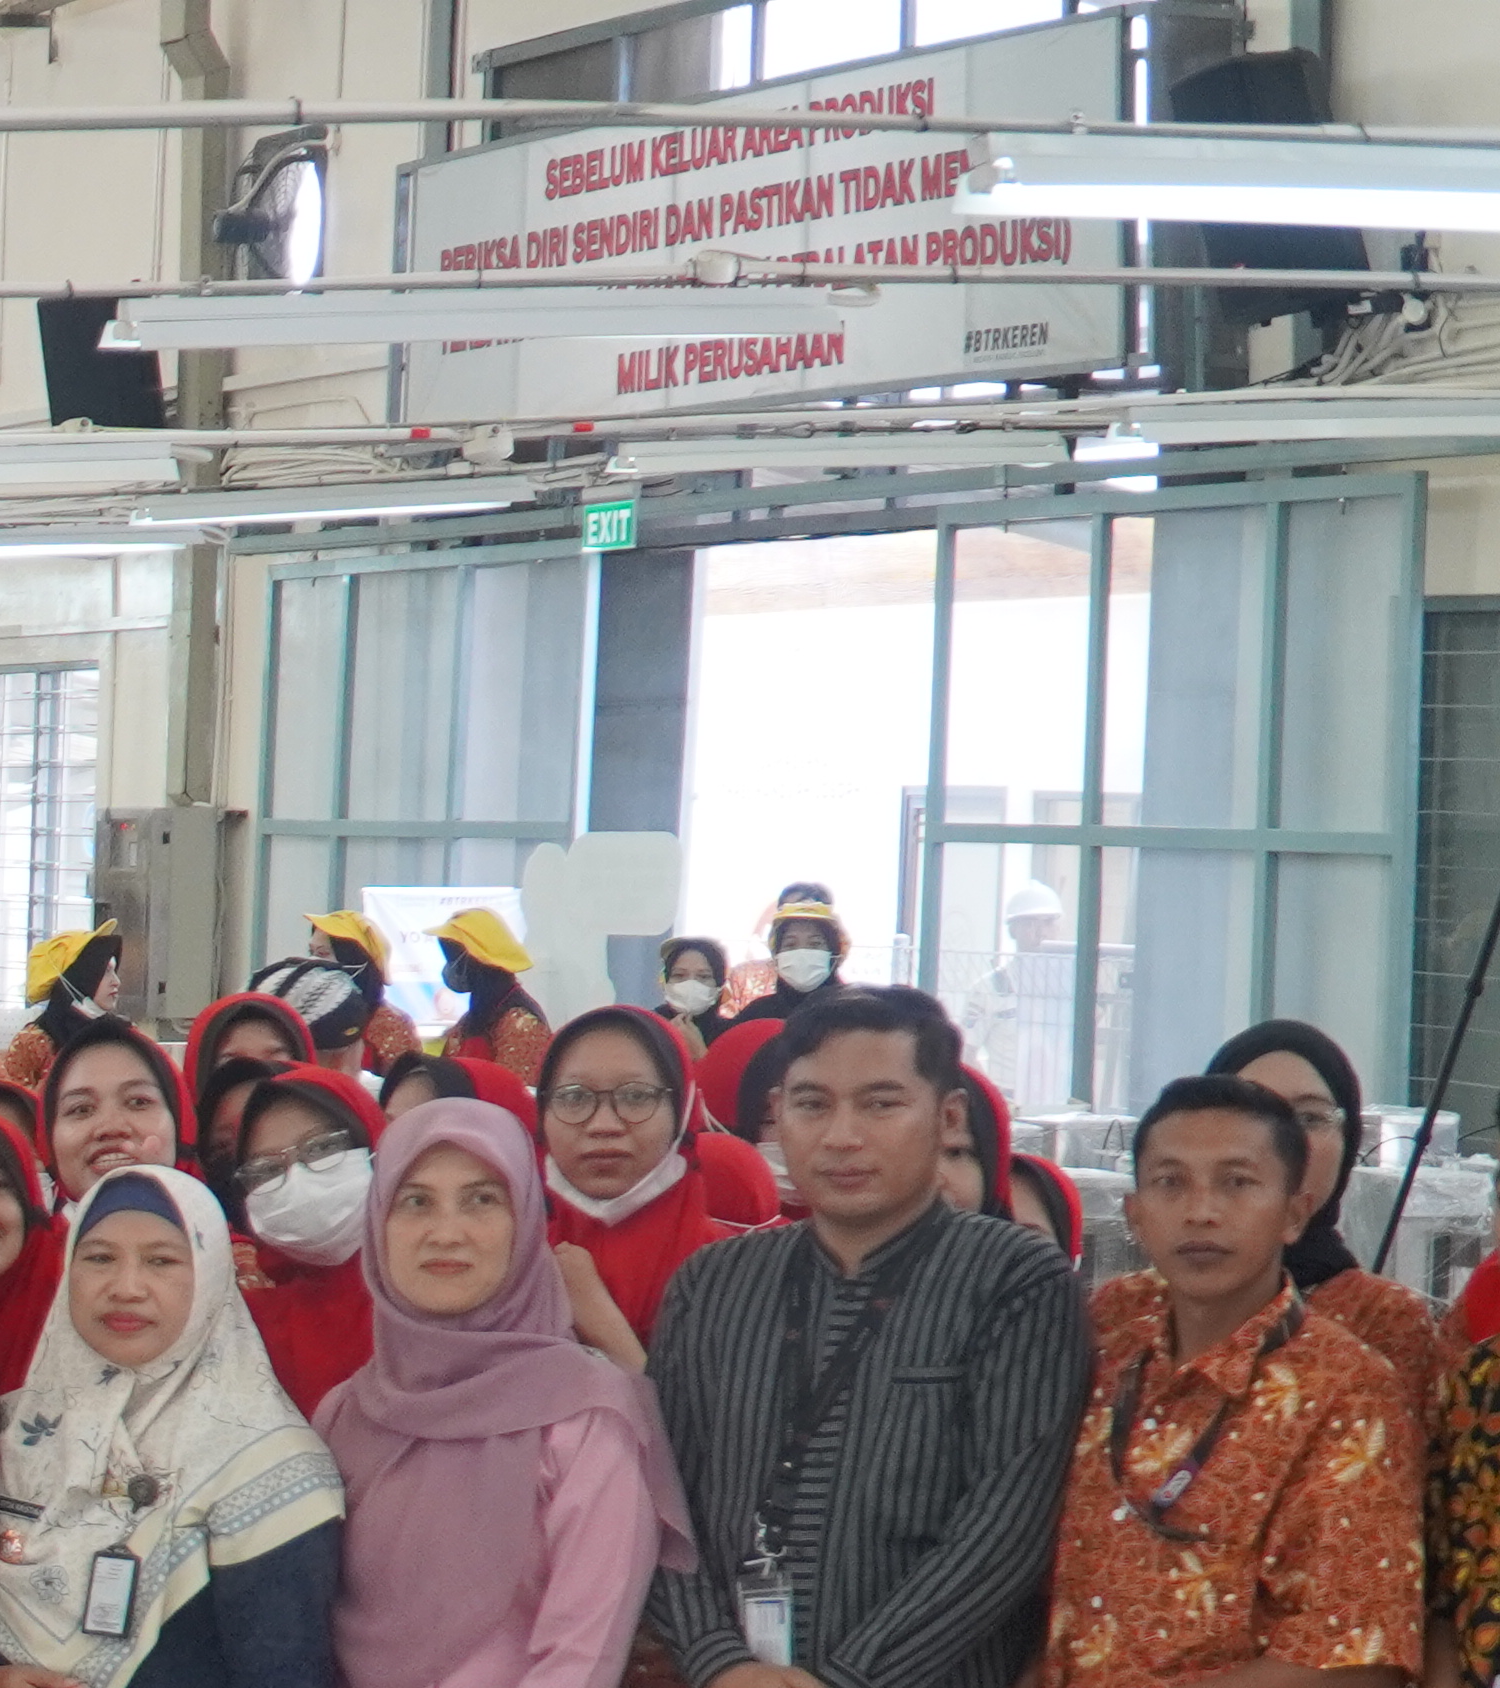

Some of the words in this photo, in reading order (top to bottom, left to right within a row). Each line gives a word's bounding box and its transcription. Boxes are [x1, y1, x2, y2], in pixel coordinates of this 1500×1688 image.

[545, 139, 645, 200] SEBELUM
[650, 126, 738, 177] KELUAR
[741, 105, 804, 160] AREA
[808, 77, 934, 146] PRODUKSI
[526, 225, 568, 268] DIRI
[572, 207, 660, 262] SENDIRI
[665, 197, 714, 248] DAN
[719, 173, 835, 237] PASTIKAN
[840, 158, 916, 215] TIDAK
[926, 217, 1073, 267] PRODUKSI)
[617, 341, 680, 394] MILIK
[684, 320, 845, 384] PERUSAHAAN
[964, 321, 1049, 354] #BTRKEREN
[587, 509, 631, 546] EXIT
